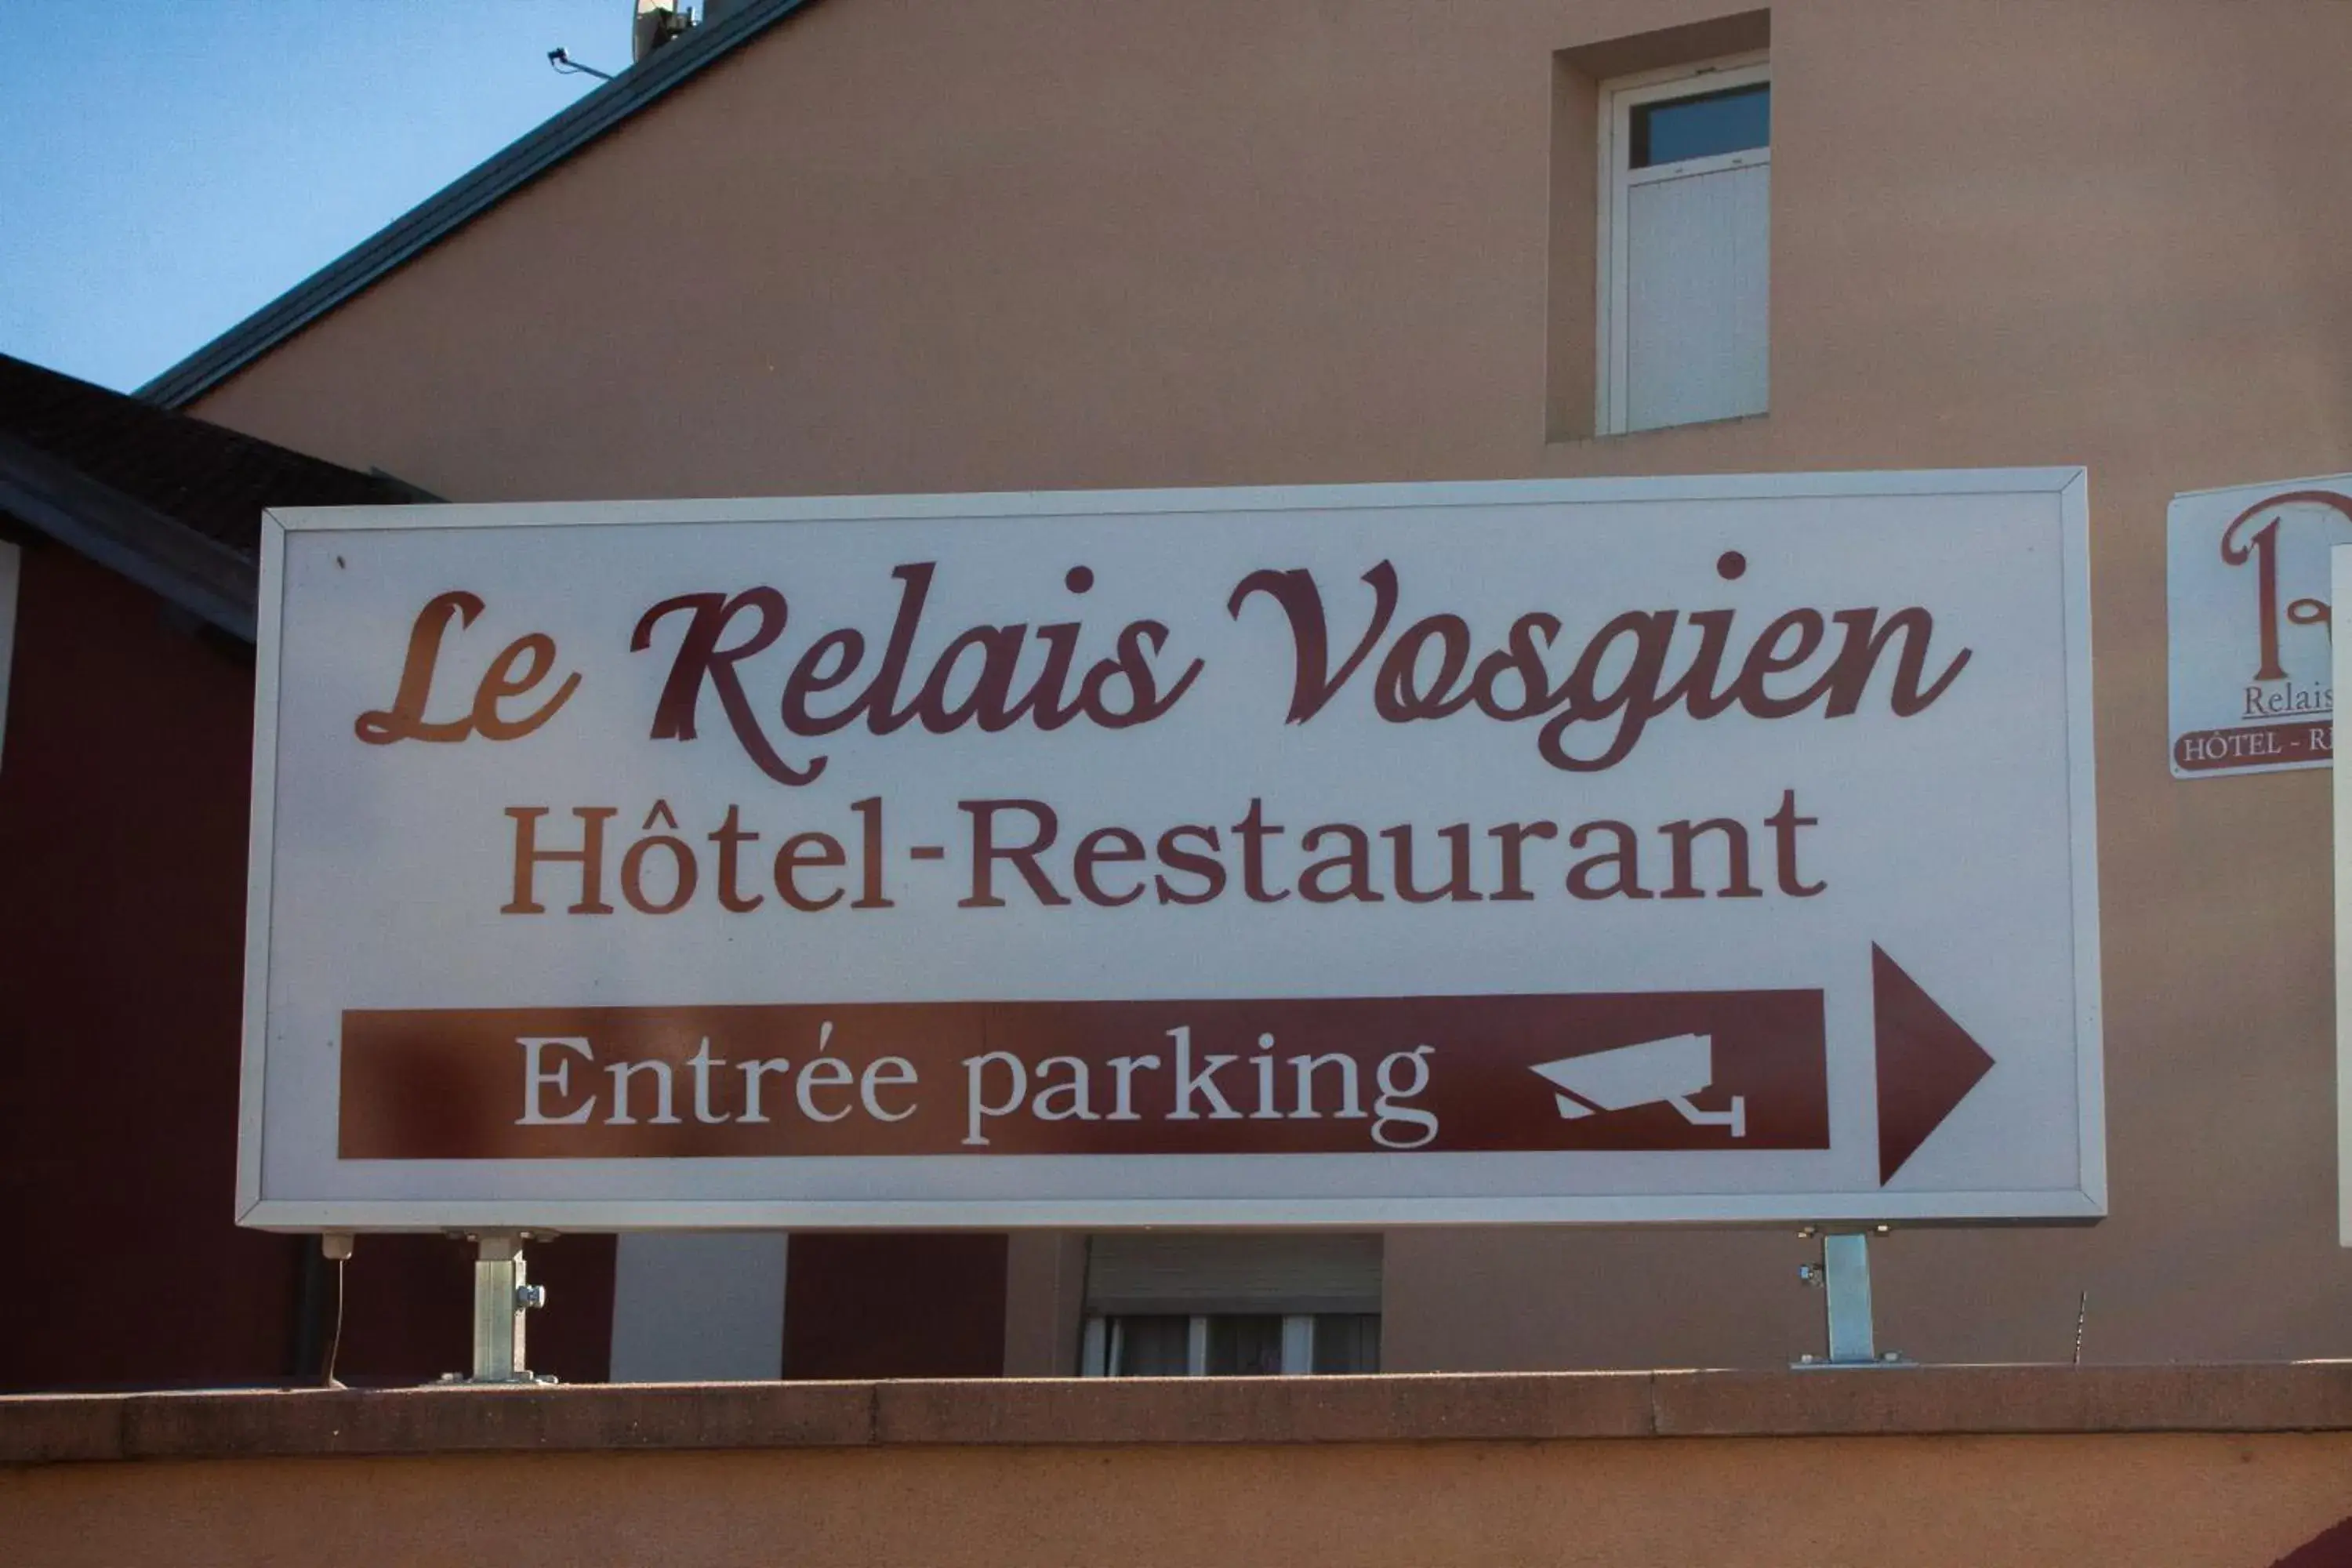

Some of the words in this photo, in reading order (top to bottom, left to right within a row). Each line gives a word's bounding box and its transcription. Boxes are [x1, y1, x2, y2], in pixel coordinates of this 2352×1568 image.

[354, 590, 582, 745] Le
[630, 561, 1204, 786] Relais
[1227, 551, 1972, 772] Vosgien
[2243, 681, 2333, 715] Relais
[2183, 730, 2283, 761] HÔTEL
[500, 789, 1827, 914] Hôtel-Restaurant
[515, 1022, 917, 1124] Entrée
[962, 1026, 1438, 1148] parking
